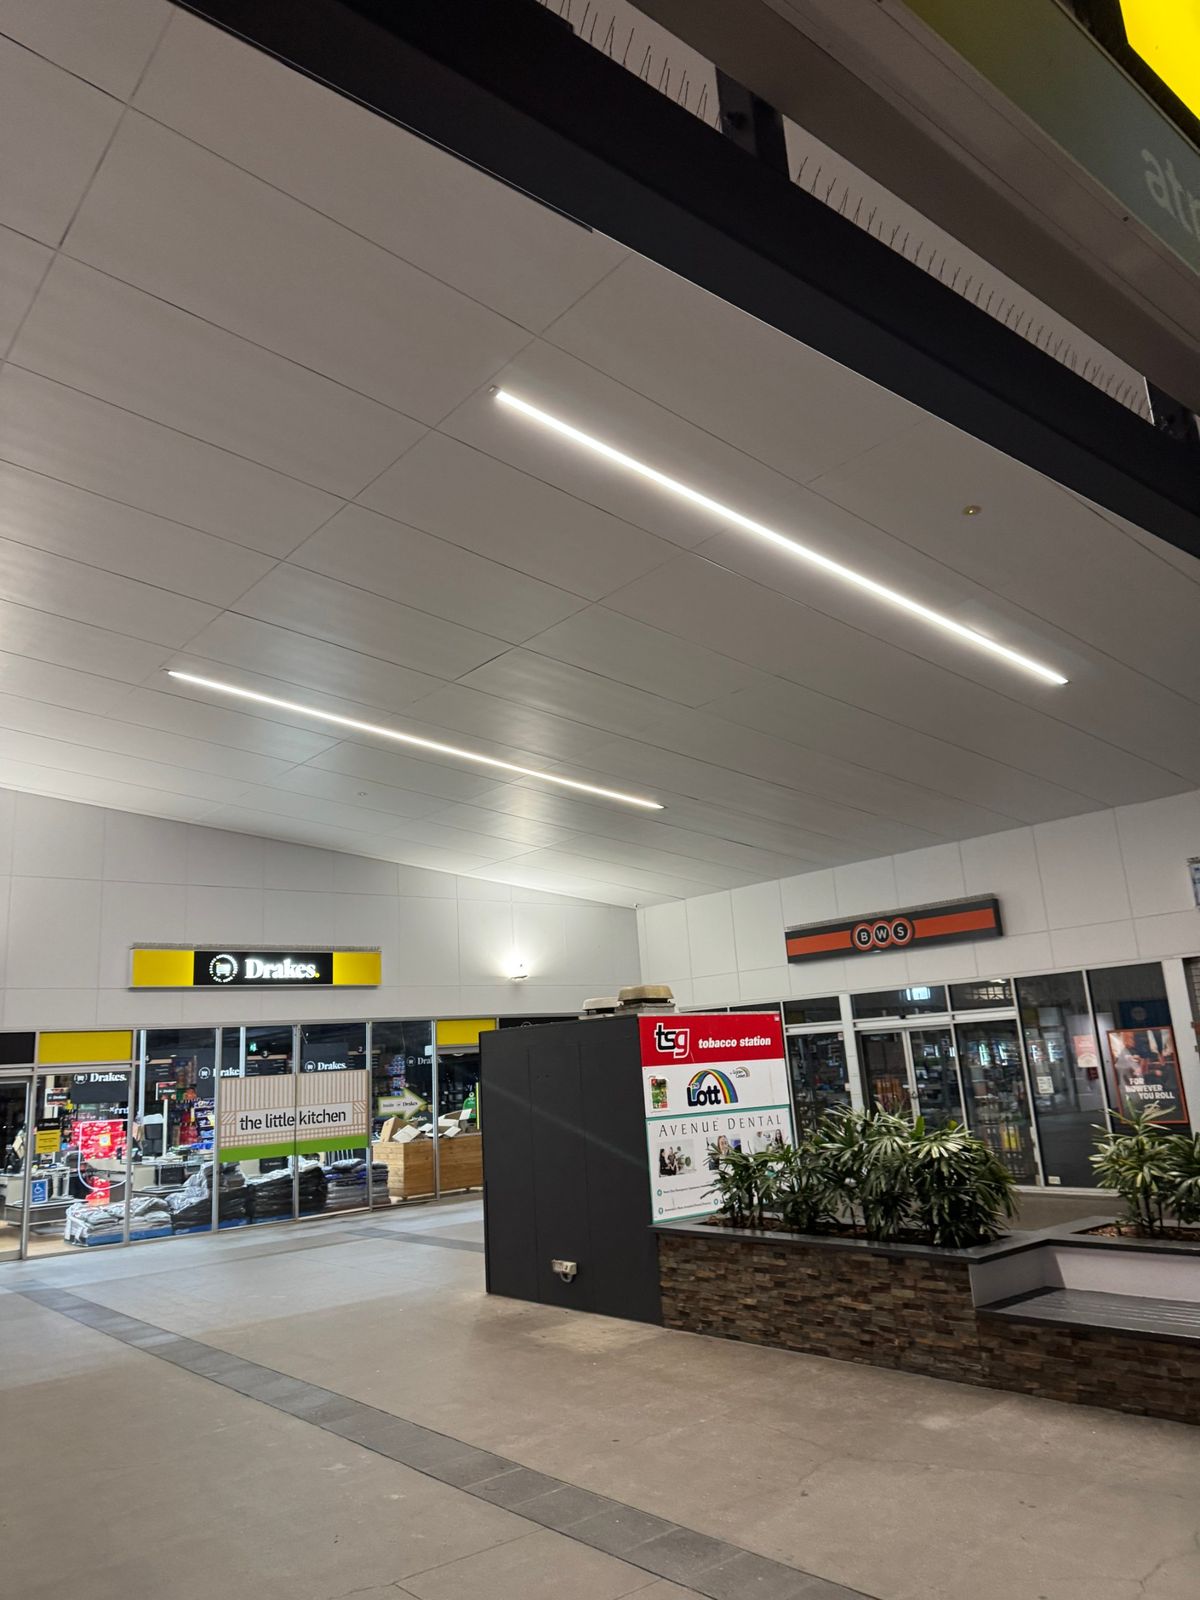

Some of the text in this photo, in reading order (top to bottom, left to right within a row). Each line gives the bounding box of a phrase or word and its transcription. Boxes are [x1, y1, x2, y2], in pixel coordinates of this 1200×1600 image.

[654, 1023, 690, 1058] tsg
[698, 1035, 771, 1049] tobacco station
[686, 1085, 722, 1107] Lott
[1125, 1084, 1164, 1093] HOWEVER
[1138, 1091, 1176, 1100] YOU ROLL
[239, 1108, 346, 1130] the little kitchen
[659, 1114, 782, 1138] AVENUE DENTAL
